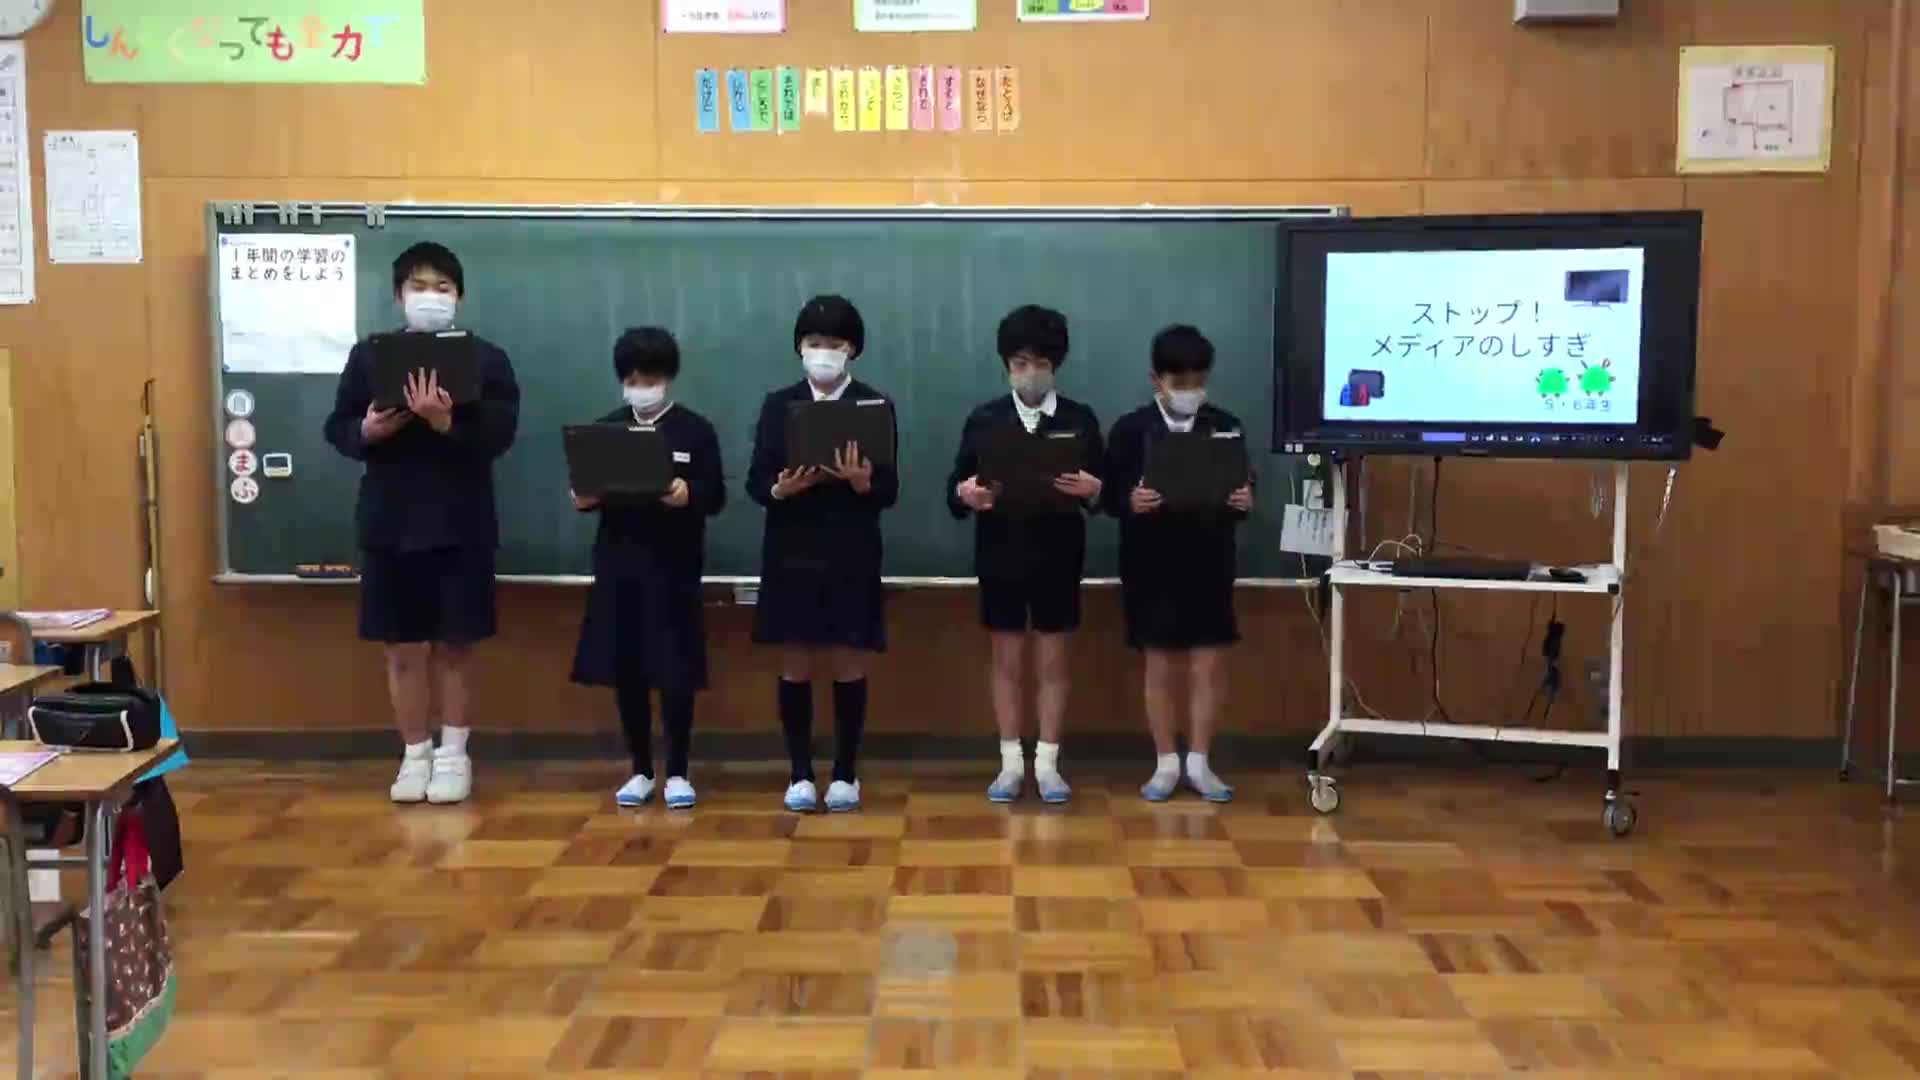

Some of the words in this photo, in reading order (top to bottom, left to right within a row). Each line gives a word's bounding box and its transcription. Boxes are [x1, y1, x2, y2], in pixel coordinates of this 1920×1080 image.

[231, 265, 345, 281] まとめをしよう
[1370, 333, 1593, 359] メディアのしすぎ
